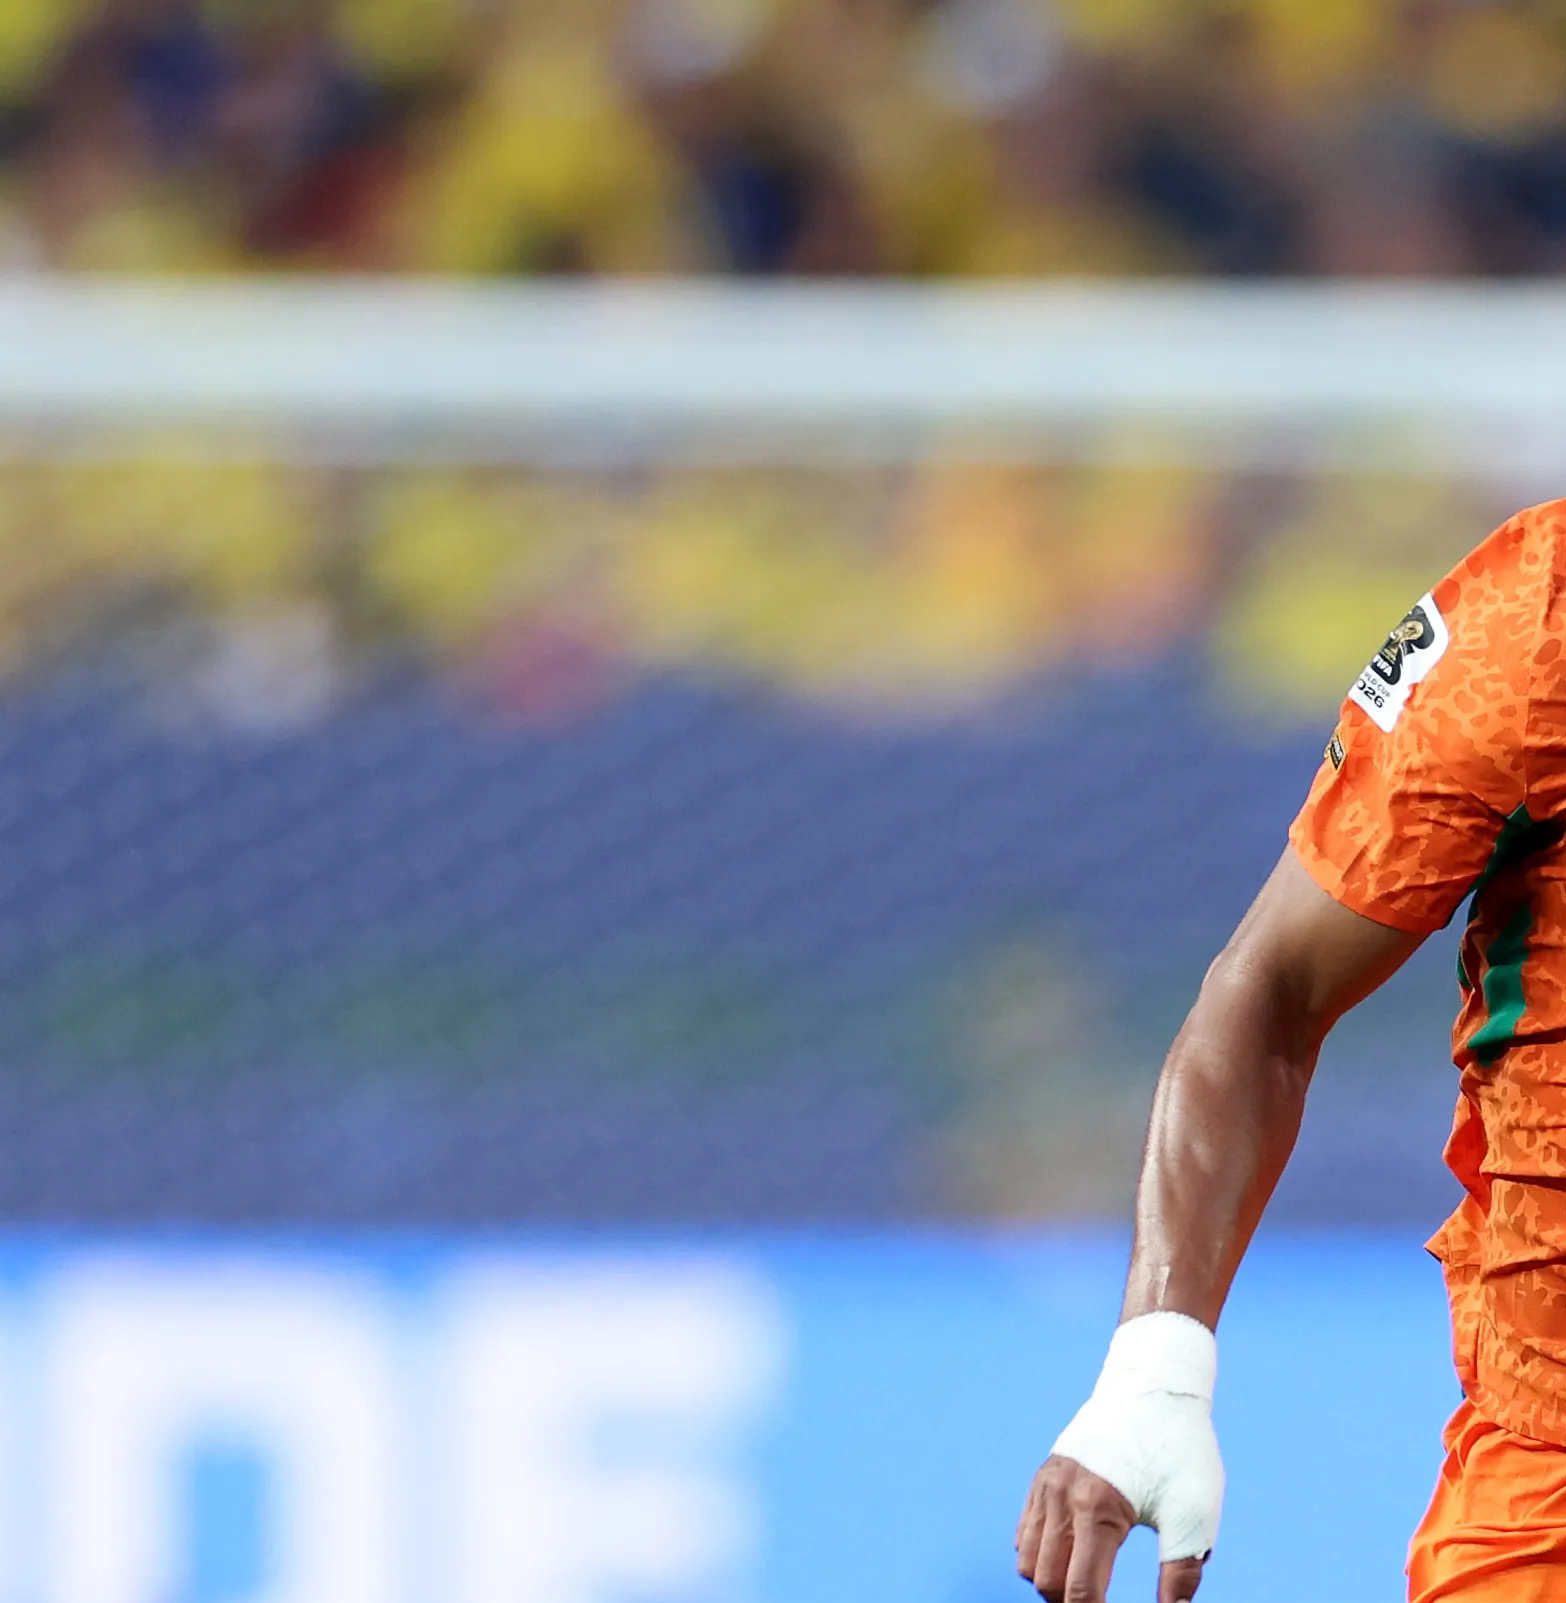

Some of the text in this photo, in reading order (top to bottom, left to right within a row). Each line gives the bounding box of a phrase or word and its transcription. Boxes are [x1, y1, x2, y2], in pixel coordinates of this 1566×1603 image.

[1373, 654, 1393, 677] FIFA
[1356, 678, 1386, 708] 026
[1377, 683, 1391, 698] CUP
